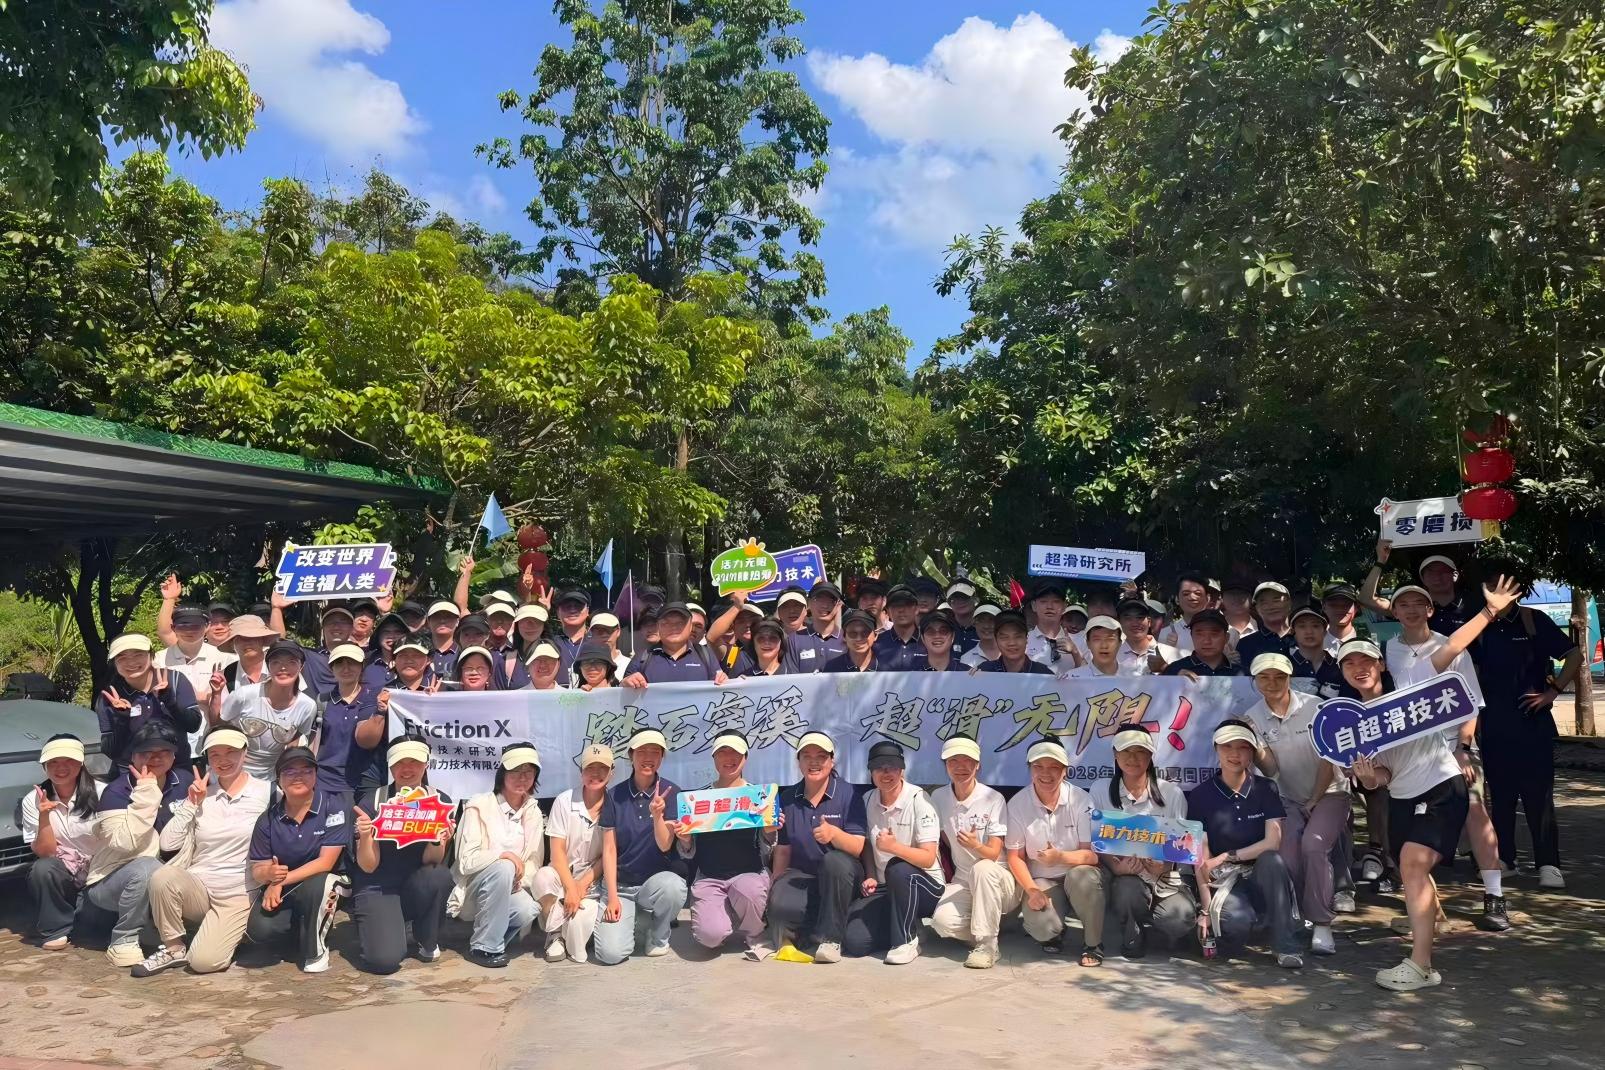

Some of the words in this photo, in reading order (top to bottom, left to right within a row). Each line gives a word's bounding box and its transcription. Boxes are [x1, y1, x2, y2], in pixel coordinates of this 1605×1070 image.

[296, 547, 375, 567] 改变世界
[1044, 552, 1132, 573] 超滑研究所
[296, 572, 376, 593] 造福人类
[404, 718, 490, 739] Friction
[1334, 687, 1461, 754] 自超滑技术
[1064, 765, 1114, 780] 025年
